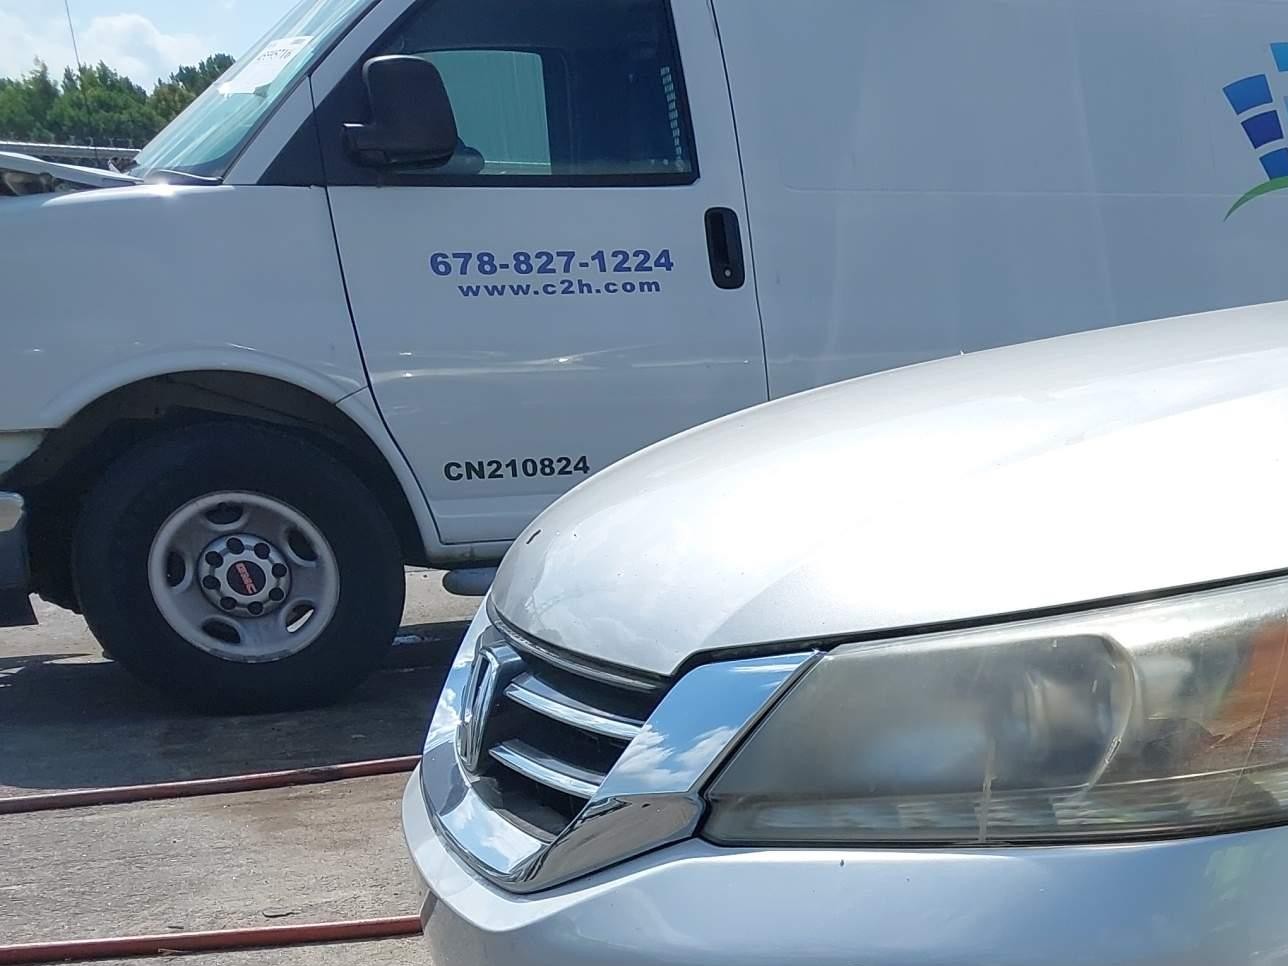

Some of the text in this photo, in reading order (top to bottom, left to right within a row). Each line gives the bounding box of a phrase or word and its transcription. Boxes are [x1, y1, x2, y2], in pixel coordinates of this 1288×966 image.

[430, 249, 674, 276] 678-827-1224
[458, 279, 661, 297] www.c2h.com
[443, 455, 590, 481] CN210824
